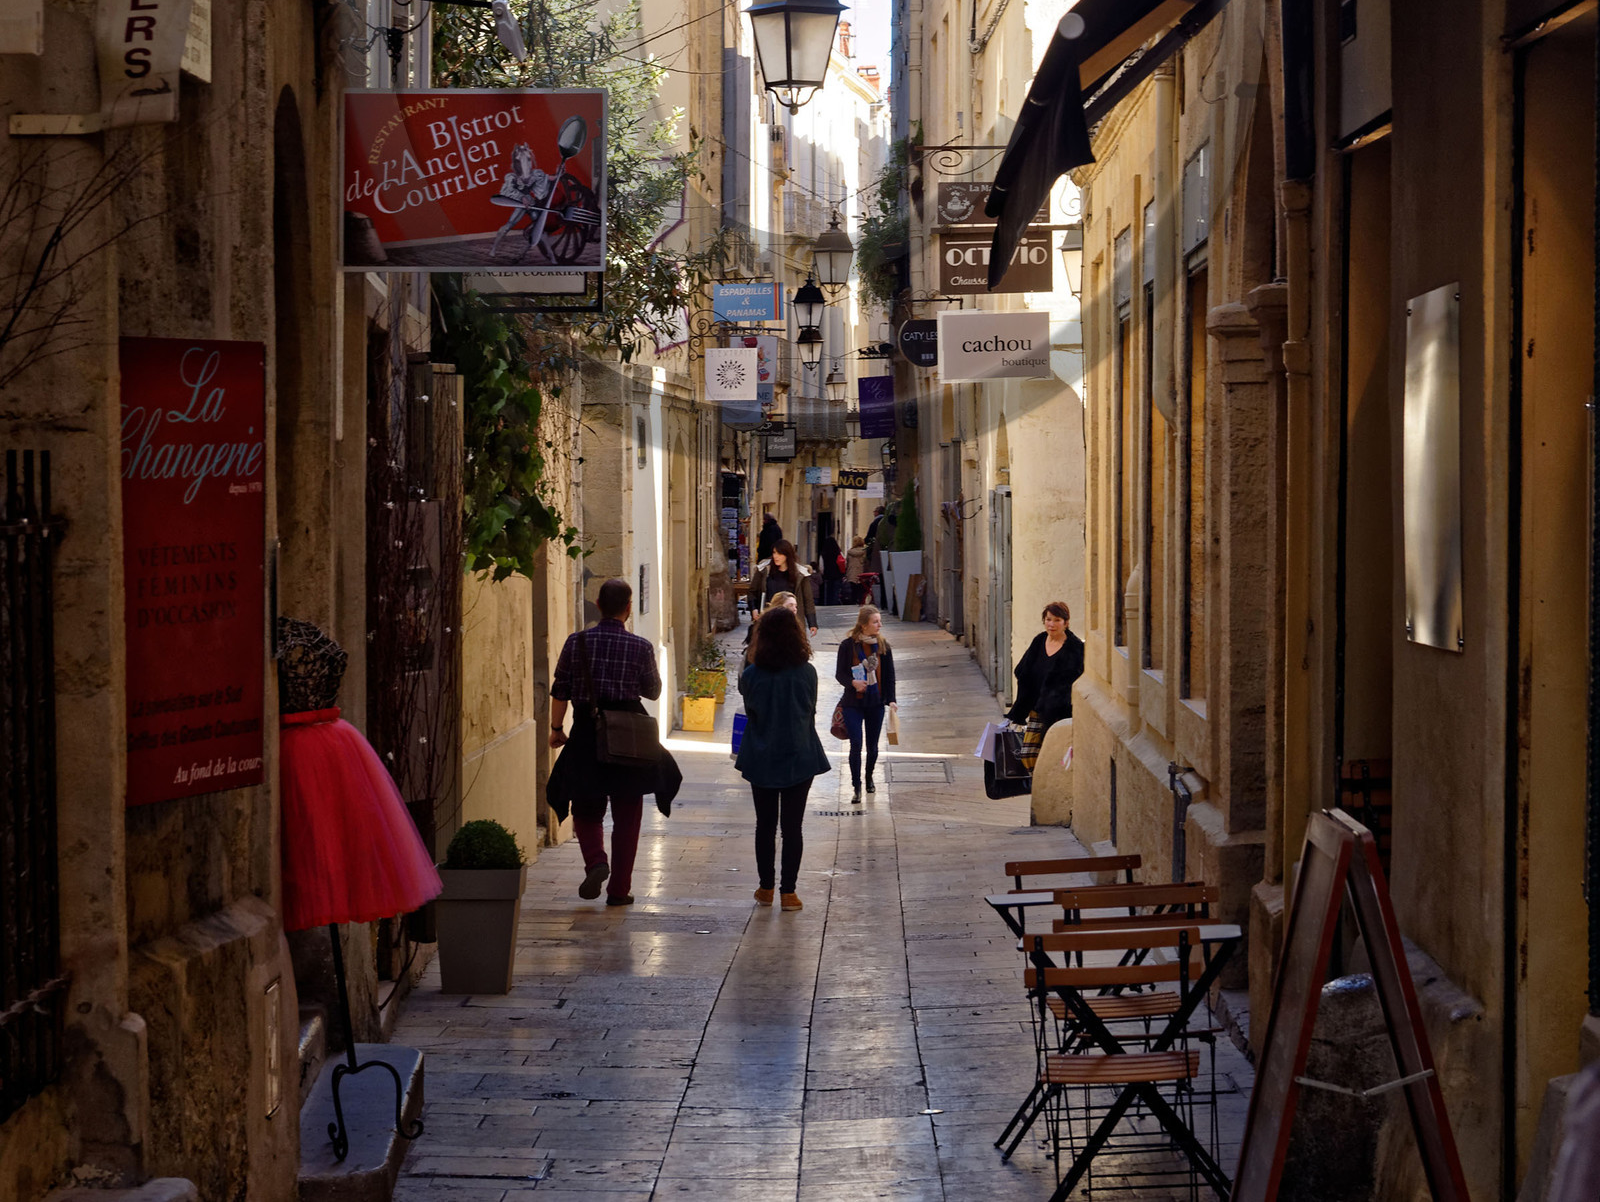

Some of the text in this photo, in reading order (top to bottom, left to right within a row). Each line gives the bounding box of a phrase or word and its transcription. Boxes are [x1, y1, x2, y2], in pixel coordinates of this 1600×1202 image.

[368, 97, 449, 165] RESTAURANT
[346, 170, 374, 202] de
[373, 162, 500, 214] Courrier
[719, 287, 773, 297] ESPADRILLES
[741, 297, 751, 305] &
[726, 308, 767, 317] PANAMAS
[902, 331, 925, 342] CATY
[962, 335, 1032, 353] cachou
[1001, 357, 1048, 369] boutique
[166, 347, 226, 423] La
[173, 766, 189, 784] Au
[187, 759, 213, 786] fond
[213, 758, 226, 776] de
[226, 756, 237, 774] la
